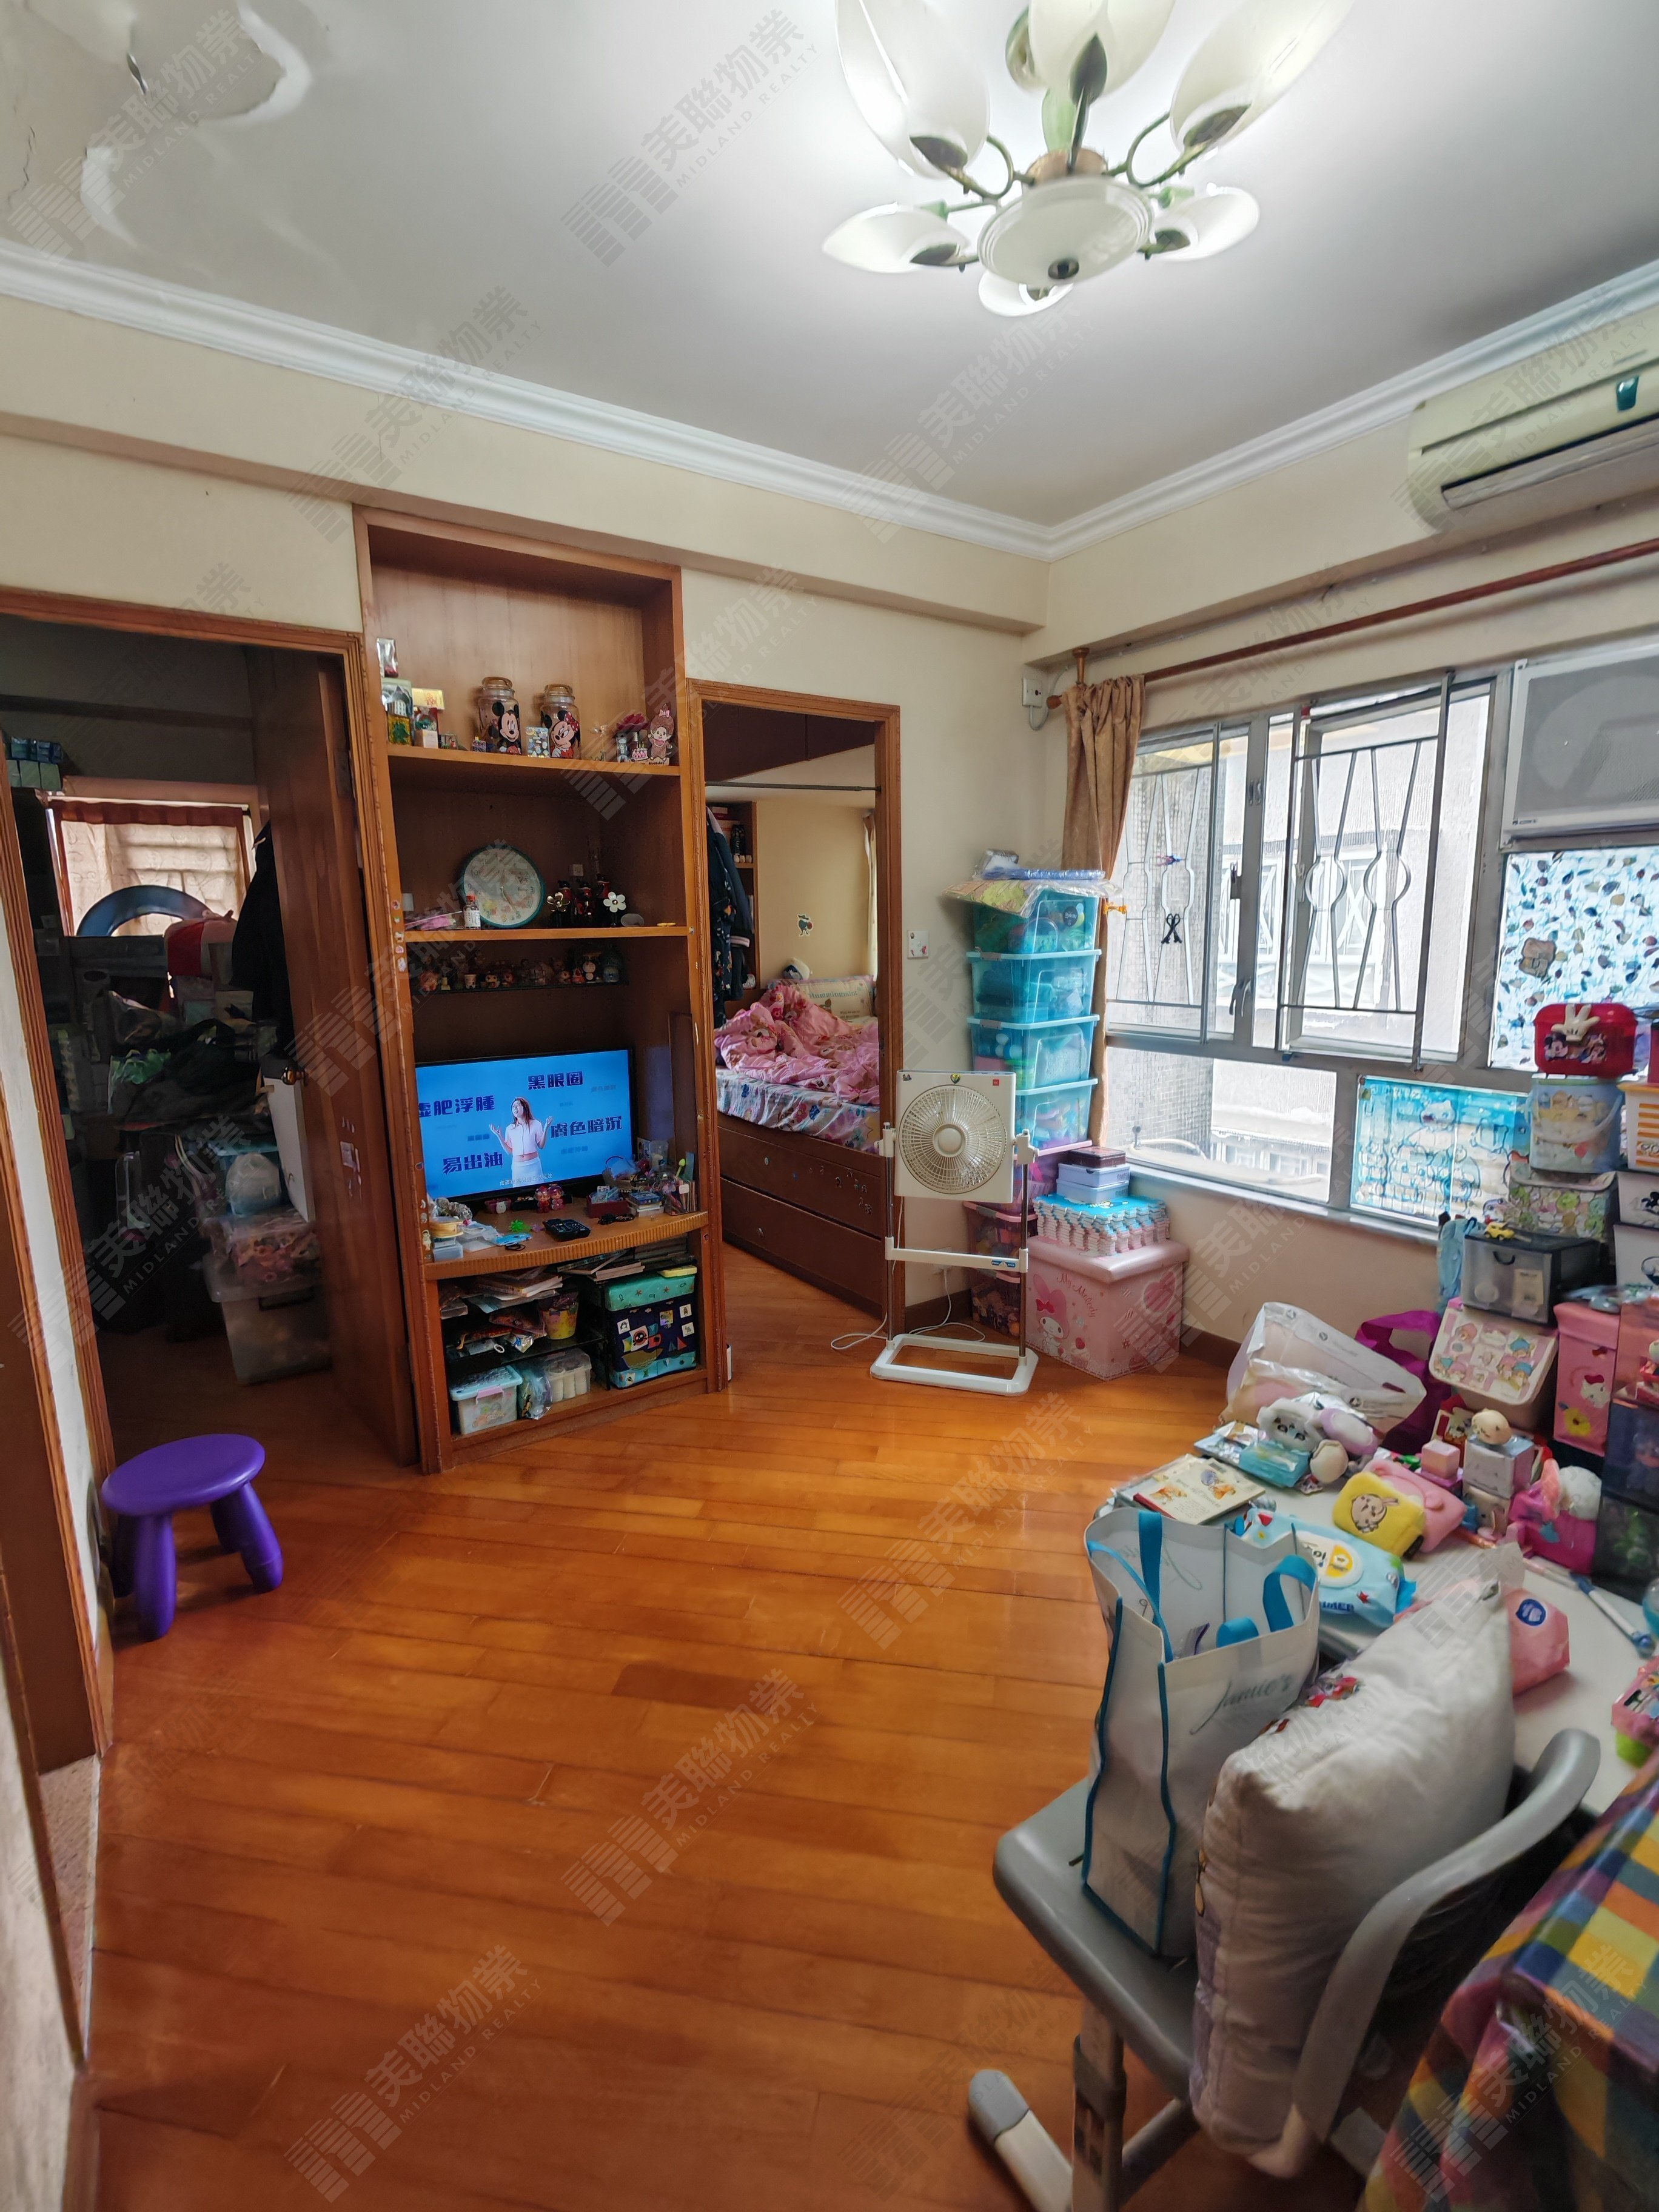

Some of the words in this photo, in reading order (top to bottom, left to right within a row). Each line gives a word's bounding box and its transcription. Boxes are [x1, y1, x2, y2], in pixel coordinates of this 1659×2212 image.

[528, 1071, 583, 1090] 黑眼圈
[551, 1116, 623, 1139] 膚色暗沉
[442, 1151, 503, 1175] 易出油
[1056, 1273, 1072, 1289] My
[1073, 1285, 1098, 1318] Melody
